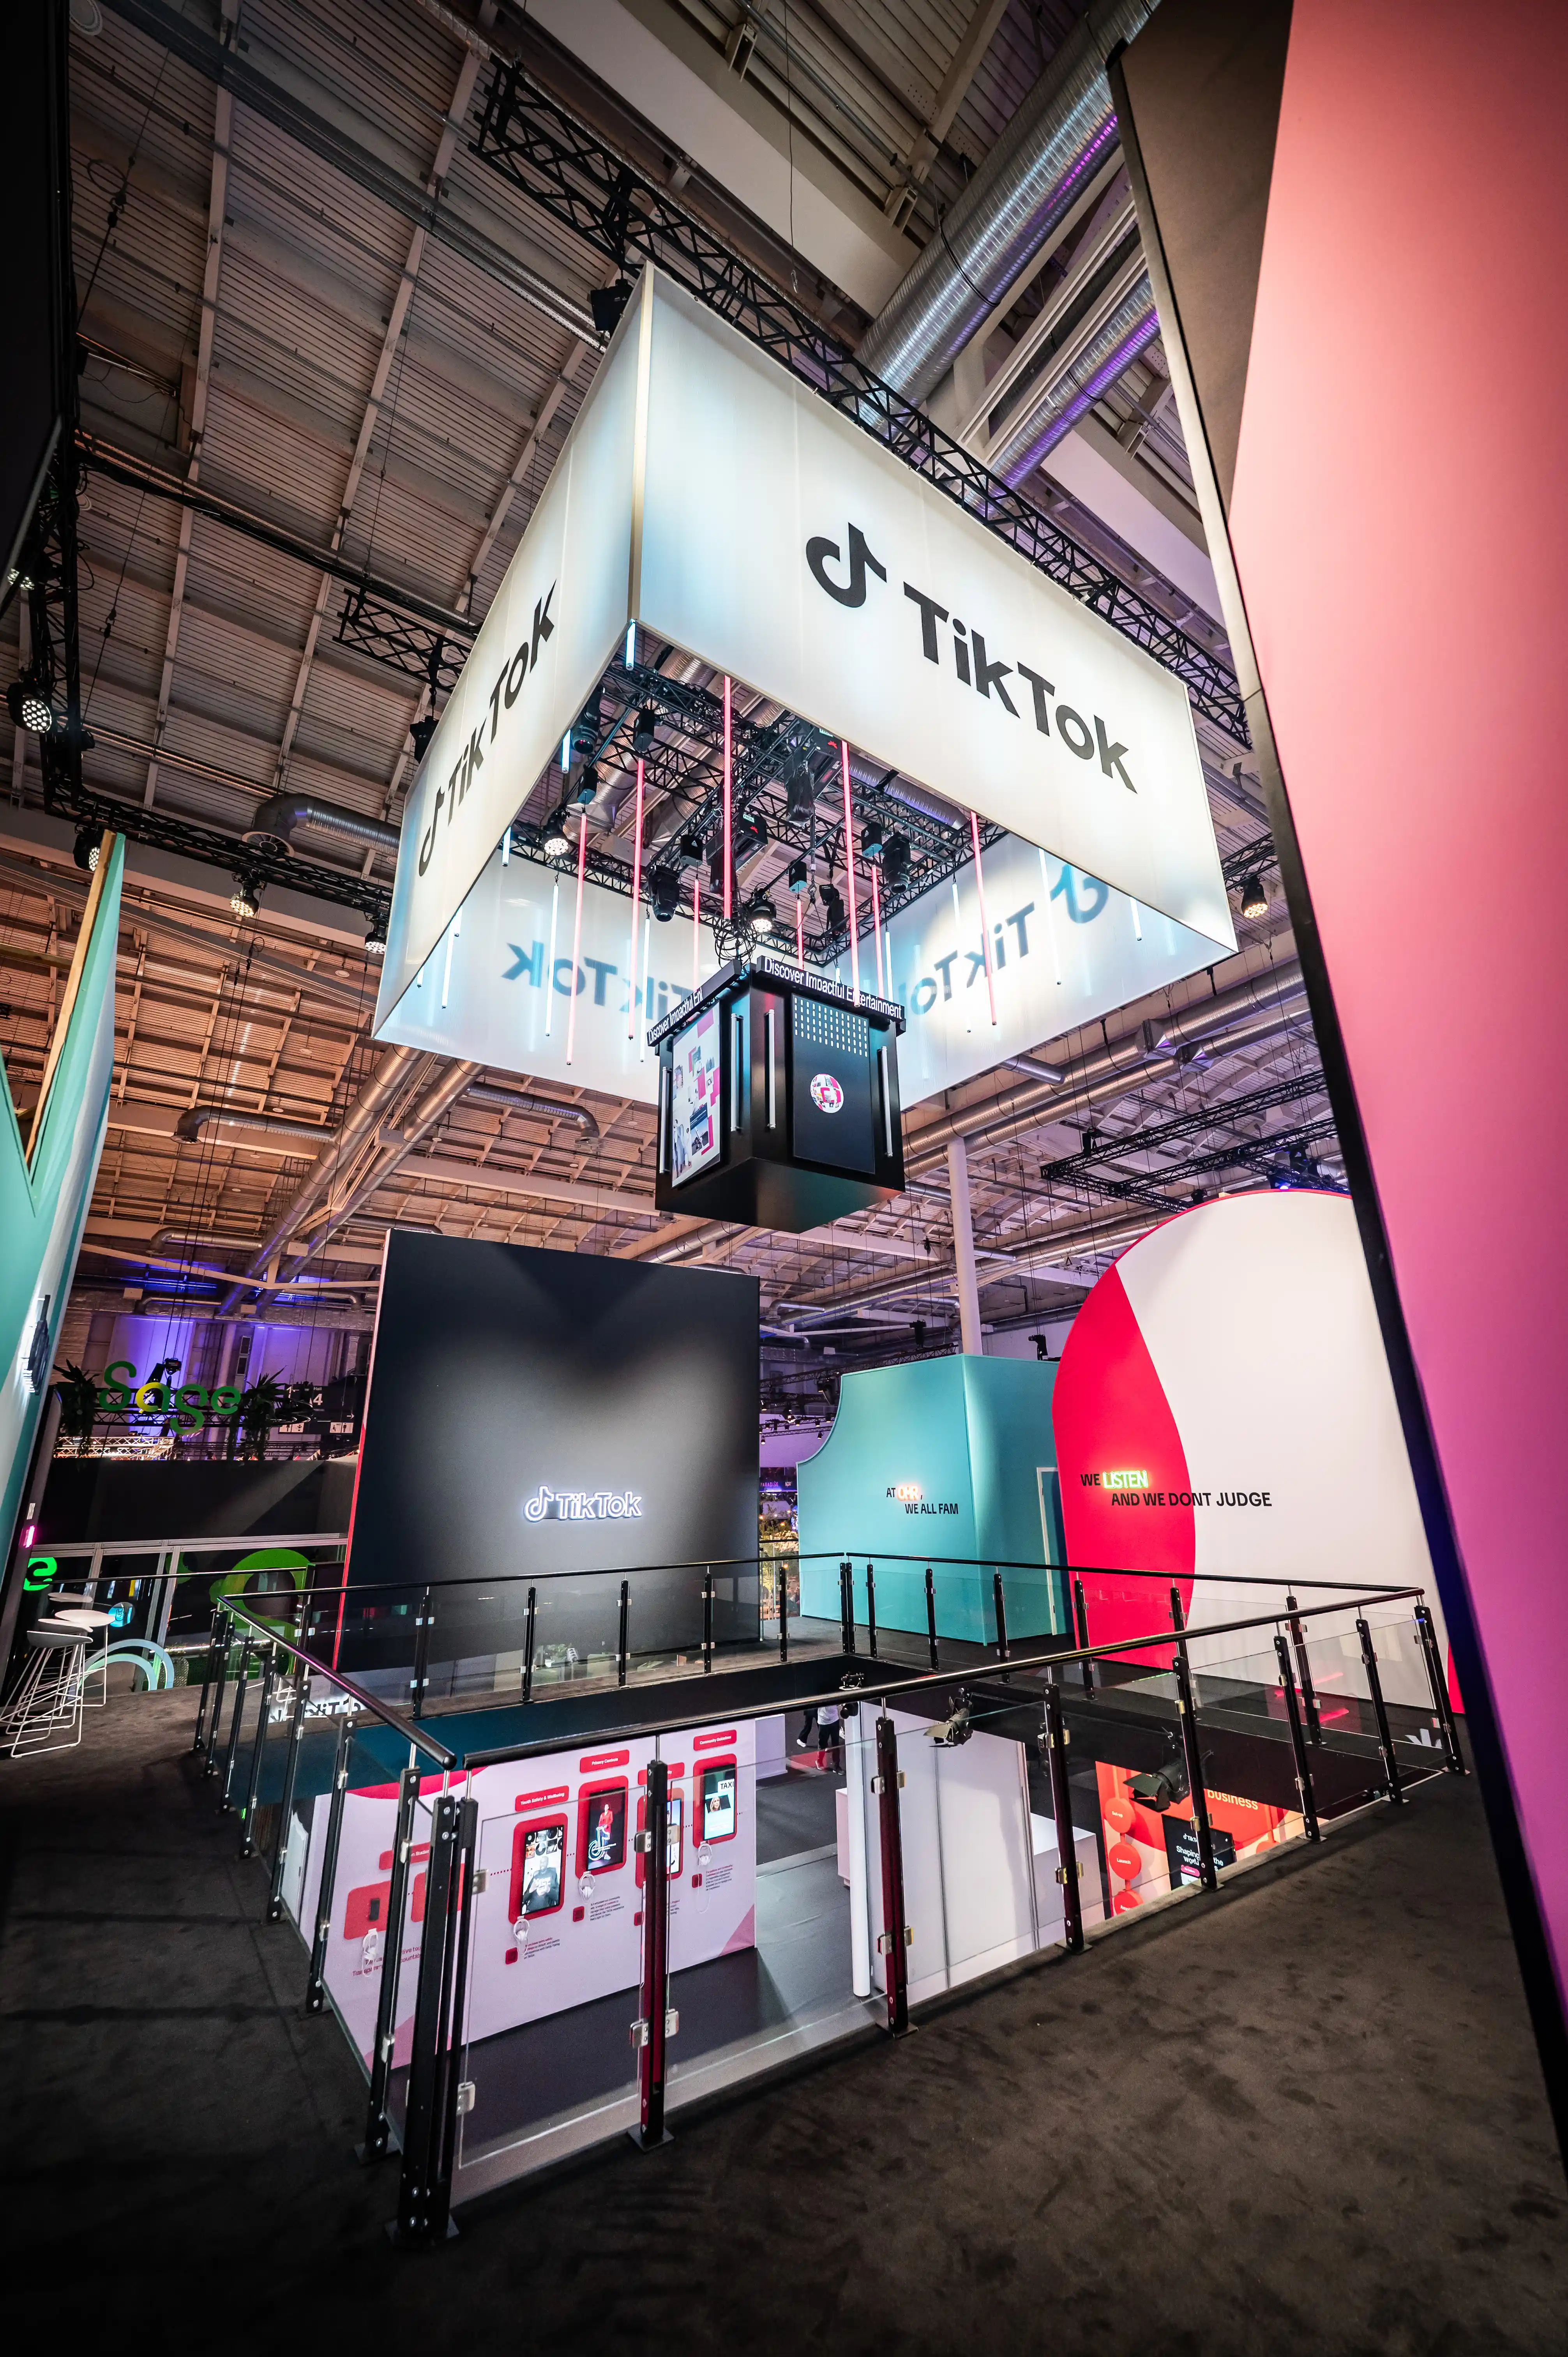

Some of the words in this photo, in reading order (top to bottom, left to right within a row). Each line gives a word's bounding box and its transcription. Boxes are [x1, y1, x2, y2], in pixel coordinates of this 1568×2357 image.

[903, 581, 1138, 794] TikTok
[448, 580, 557, 826] TikTok
[765, 958, 804, 985] Discover
[806, 972, 845, 999] Impactful
[648, 1018, 669, 1044] Discover
[669, 995, 694, 1027] Impactful
[99, 1360, 241, 1435] Sage
[313, 1393, 323, 1406] 4
[1080, 1474, 1101, 1486] WE
[1102, 1470, 1149, 1489] LISTEN
[886, 1488, 896, 1498] AT
[1111, 1493, 1140, 1506] AND
[1143, 1492, 1165, 1506] WE
[1169, 1492, 1211, 1507] DONT
[1216, 1492, 1272, 1507] JUDGE
[556, 1491, 642, 1520] TikTok
[905, 1503, 919, 1514] WE
[920, 1503, 937, 1514] ALL
[938, 1503, 959, 1514] FAM
[720, 1781, 735, 1790] TAXI
[1213, 1857, 1224, 1866] the
